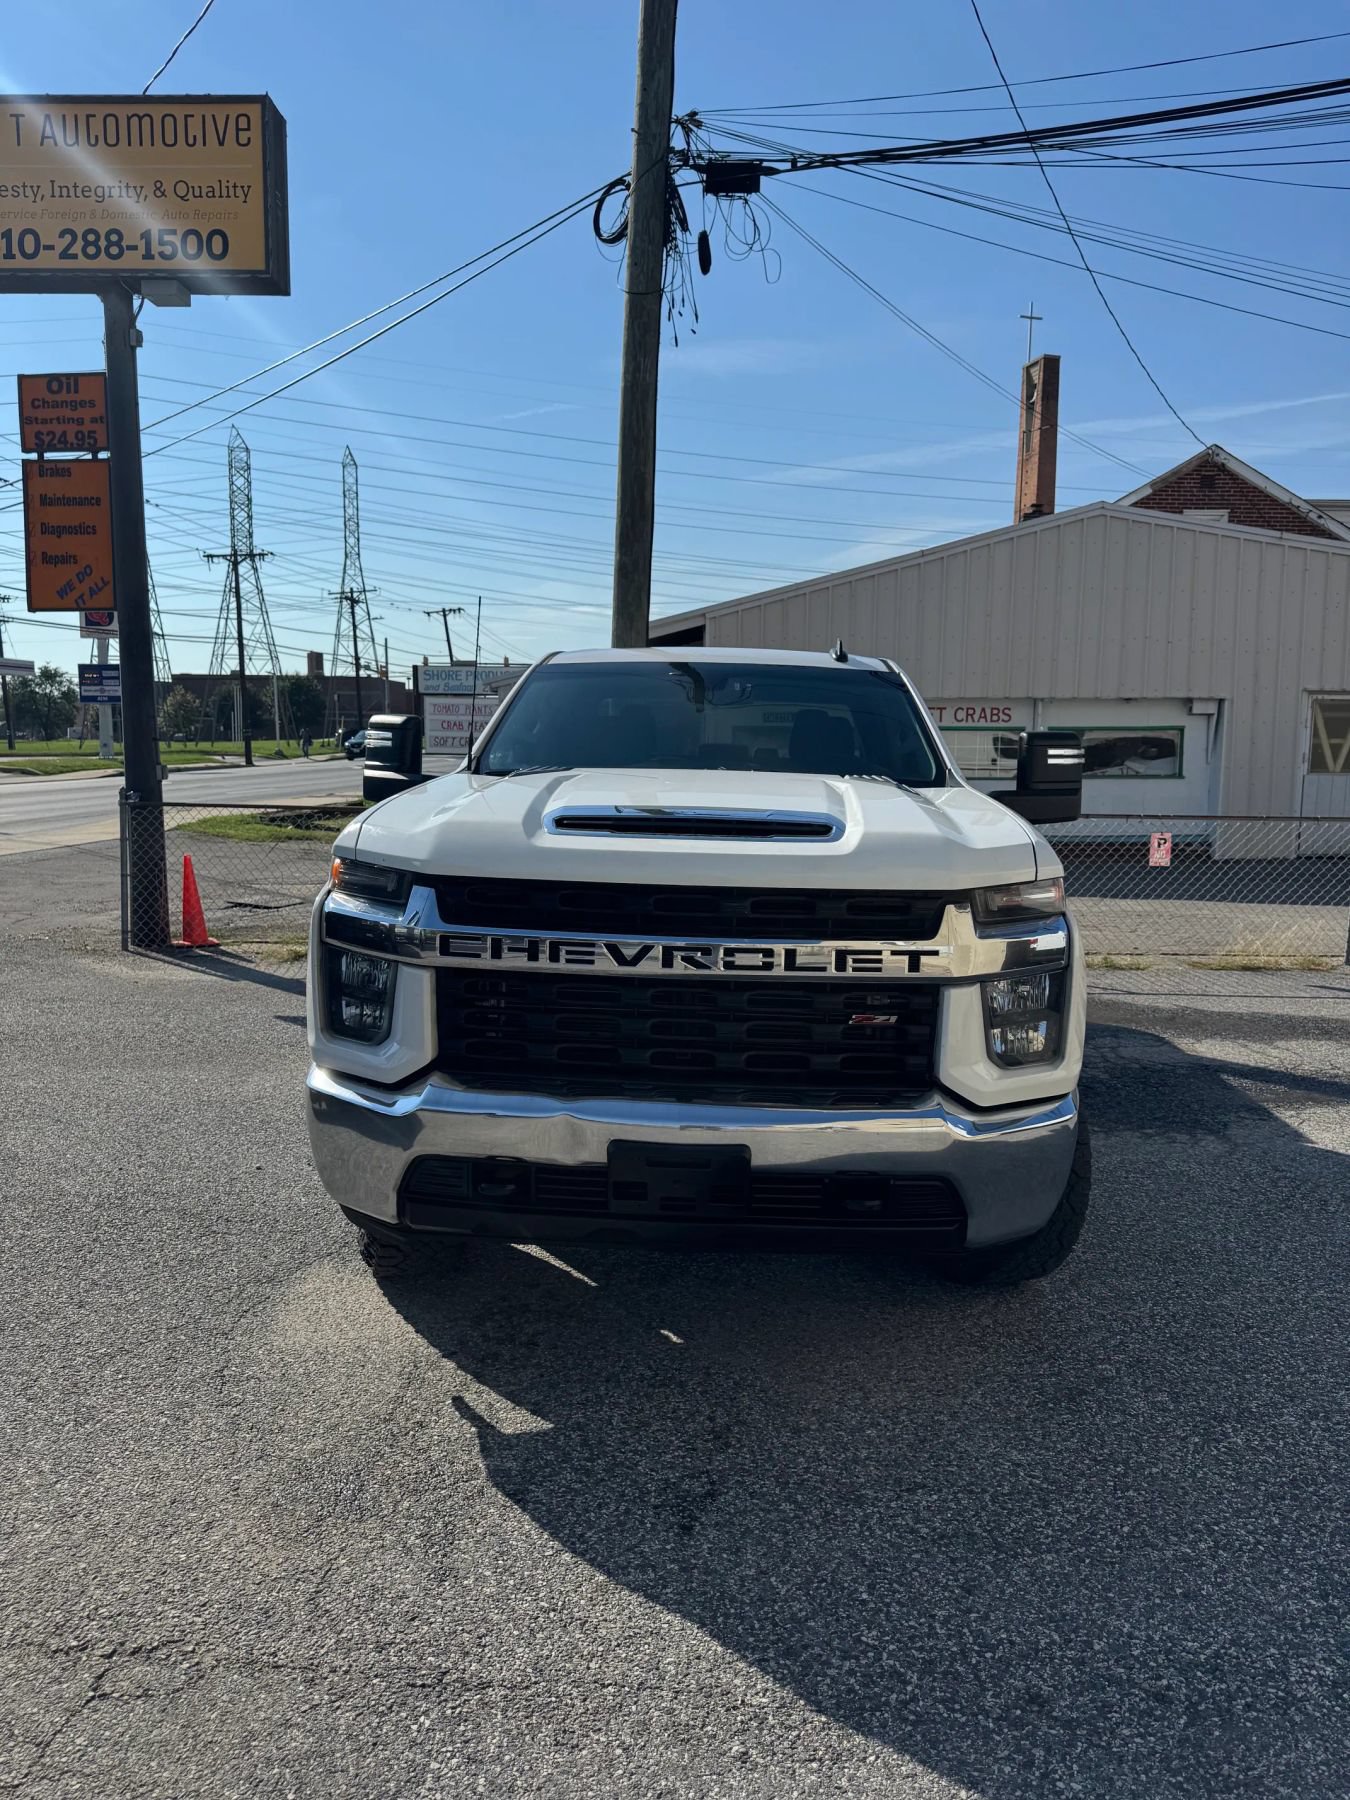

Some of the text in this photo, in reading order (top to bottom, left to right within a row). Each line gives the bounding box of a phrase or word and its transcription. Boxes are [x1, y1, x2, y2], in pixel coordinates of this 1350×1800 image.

[9, 113, 25, 147] T
[0, 179, 252, 203] esty, Integrity, & Quality
[41, 209, 87, 221] Foreign
[89, 209, 97, 219] &
[101, 209, 154, 220] Domestic
[161, 209, 190, 220] Auto
[192, 209, 239, 222] Repairs
[0, 227, 230, 261] 10-288-1500
[46, 376, 79, 395] Oil
[30, 398, 97, 411] Changes
[24, 415, 105, 426] Starting at
[34, 430, 98, 448] $24.95
[38, 464, 72, 478] Brakes
[39, 494, 101, 507] Maintenance
[40, 522, 97, 538] Diagnostics
[41, 552, 79, 568] Repairs
[56, 564, 93, 600] WE DO
[75, 576, 110, 608] IT ALL
[423, 669, 462, 681] SHORE
[432, 703, 493, 715] TOMATO PLANTS
[954, 706, 1012, 723] CRABS
[441, 720, 464, 731] CRAB
[433, 736, 455, 748] SOFT
[436, 932, 941, 976] CHEVROLET
